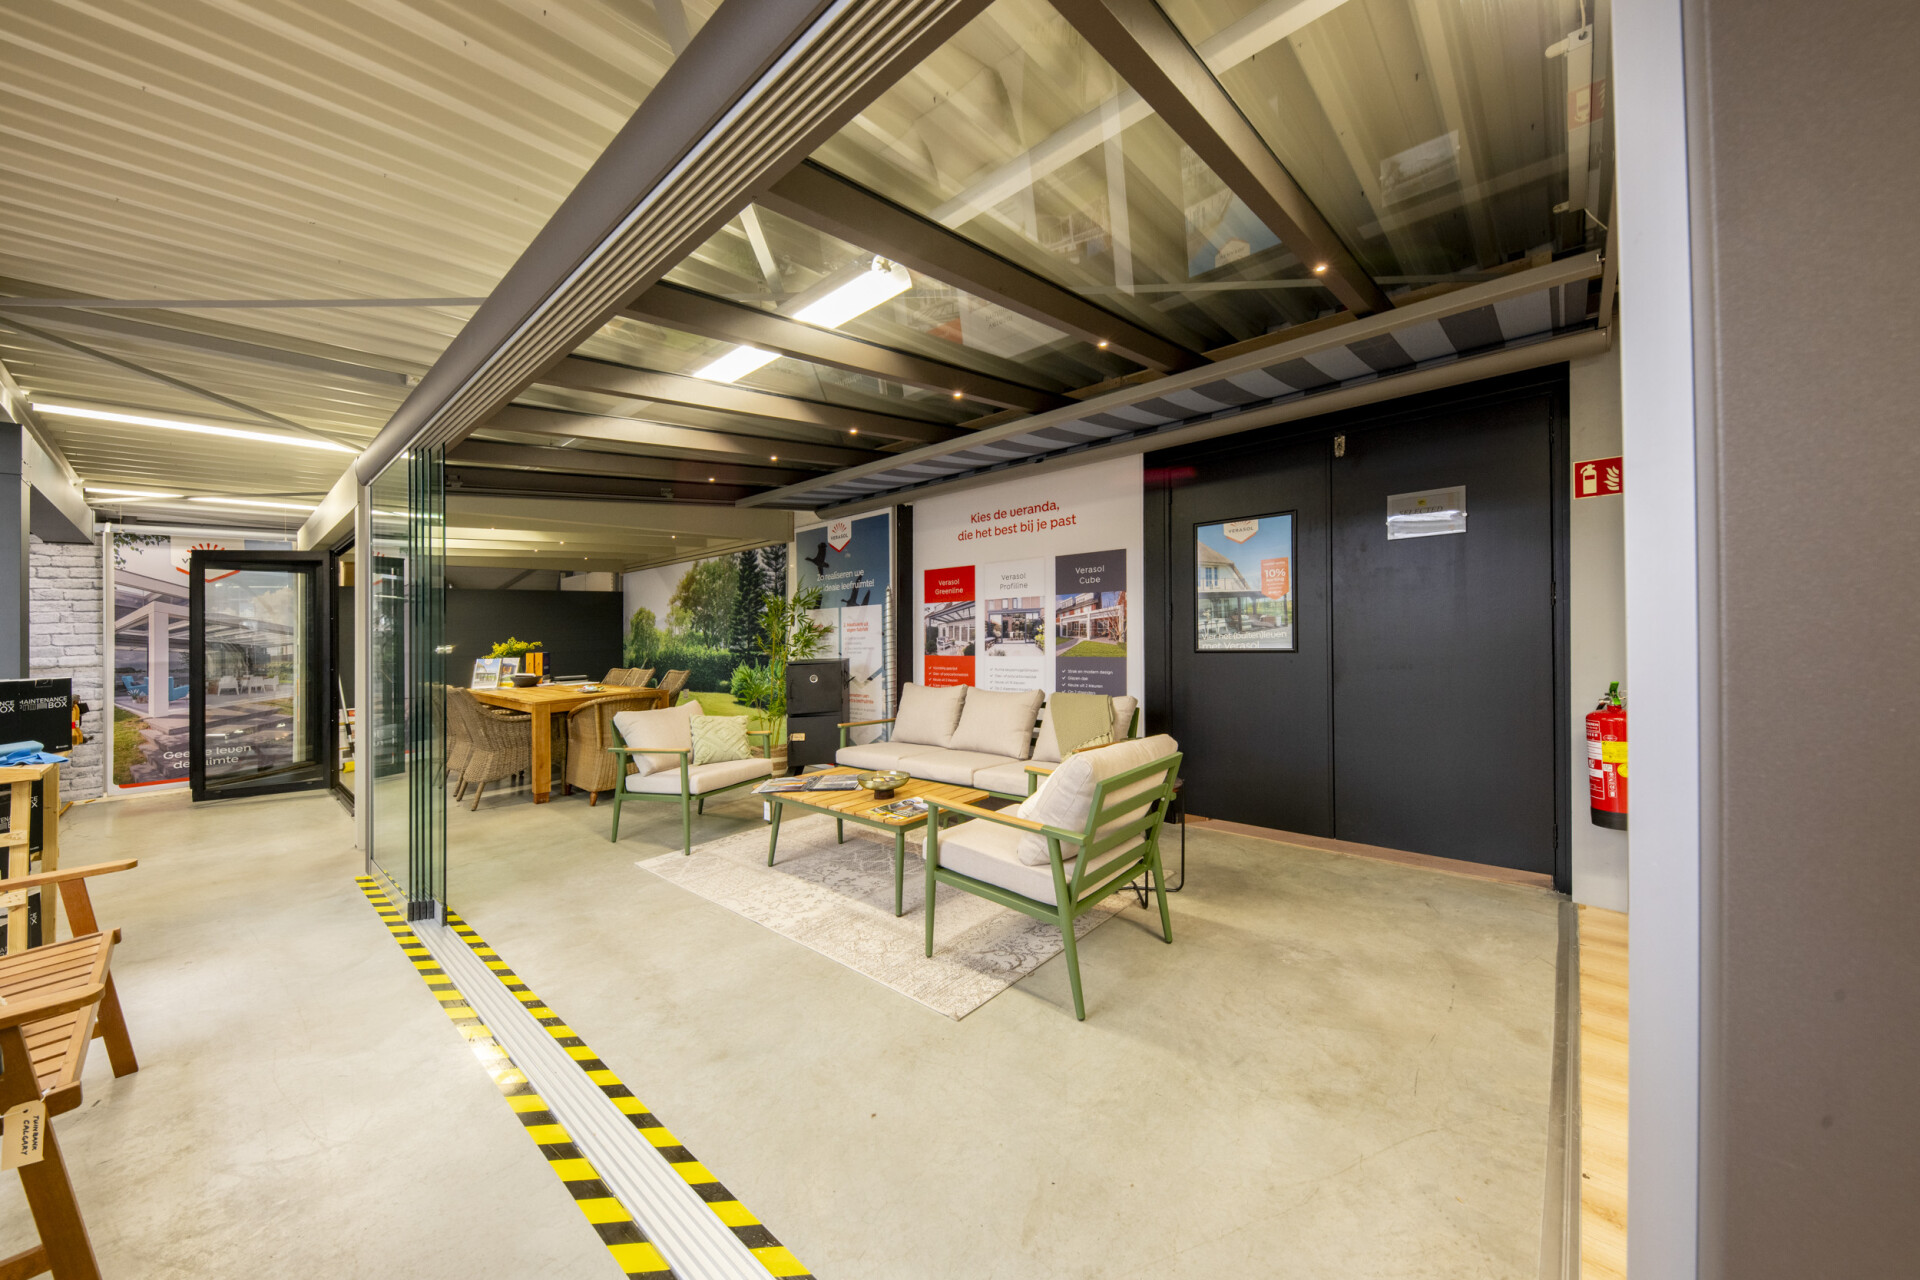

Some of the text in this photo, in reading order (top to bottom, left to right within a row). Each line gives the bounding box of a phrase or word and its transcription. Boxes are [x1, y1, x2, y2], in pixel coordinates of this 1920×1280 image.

[970, 500, 1060, 524] Kies de veranda,
[1399, 505, 1444, 515] SELECTED
[957, 514, 1077, 541] die het best bij je past
[1074, 565, 1105, 575] Verasol
[1264, 568, 1286, 577] 10%
[816, 574, 825, 582] Zo
[825, 570, 853, 580] realiseren
[1001, 572, 1026, 581] Verasol
[1079, 575, 1101, 584] Cube
[938, 578, 960, 586] Verasol
[1000, 582, 1028, 591] Profiline
[935, 586, 964, 595] Greenline
[1219, 632, 1233, 640] het
[48, 701, 68, 709] BOX
[216, 745, 252, 755] leven
[21, 1119, 30, 1156] CALGARY
